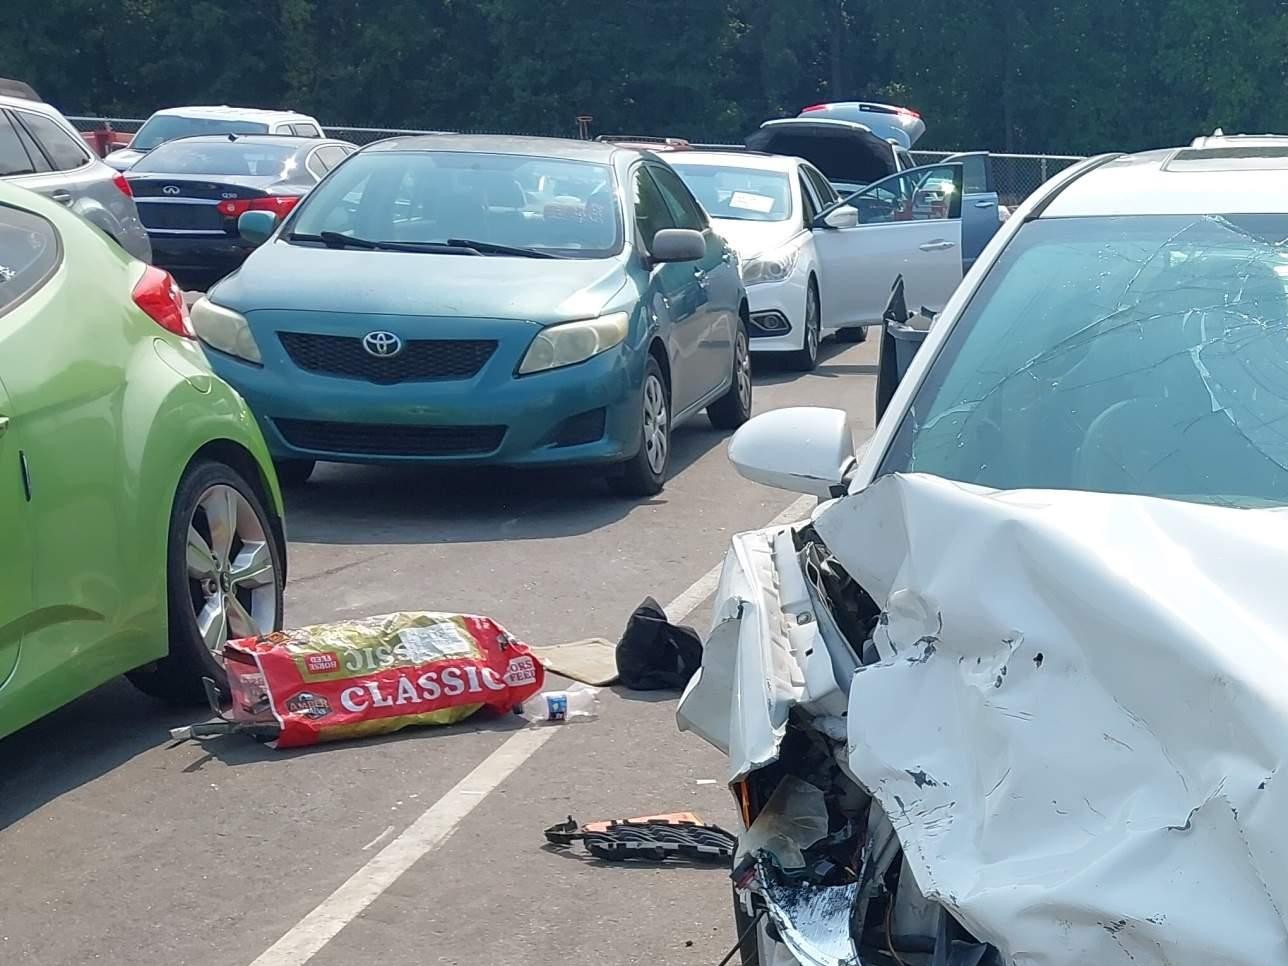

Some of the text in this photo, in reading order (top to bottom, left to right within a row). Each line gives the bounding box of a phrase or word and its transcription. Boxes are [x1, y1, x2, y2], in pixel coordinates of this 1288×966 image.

[310, 655, 332, 663] FEED
[308, 660, 337, 671] HORSE
[340, 666, 507, 713] CLASSIC
[289, 699, 329, 711] AMBER
